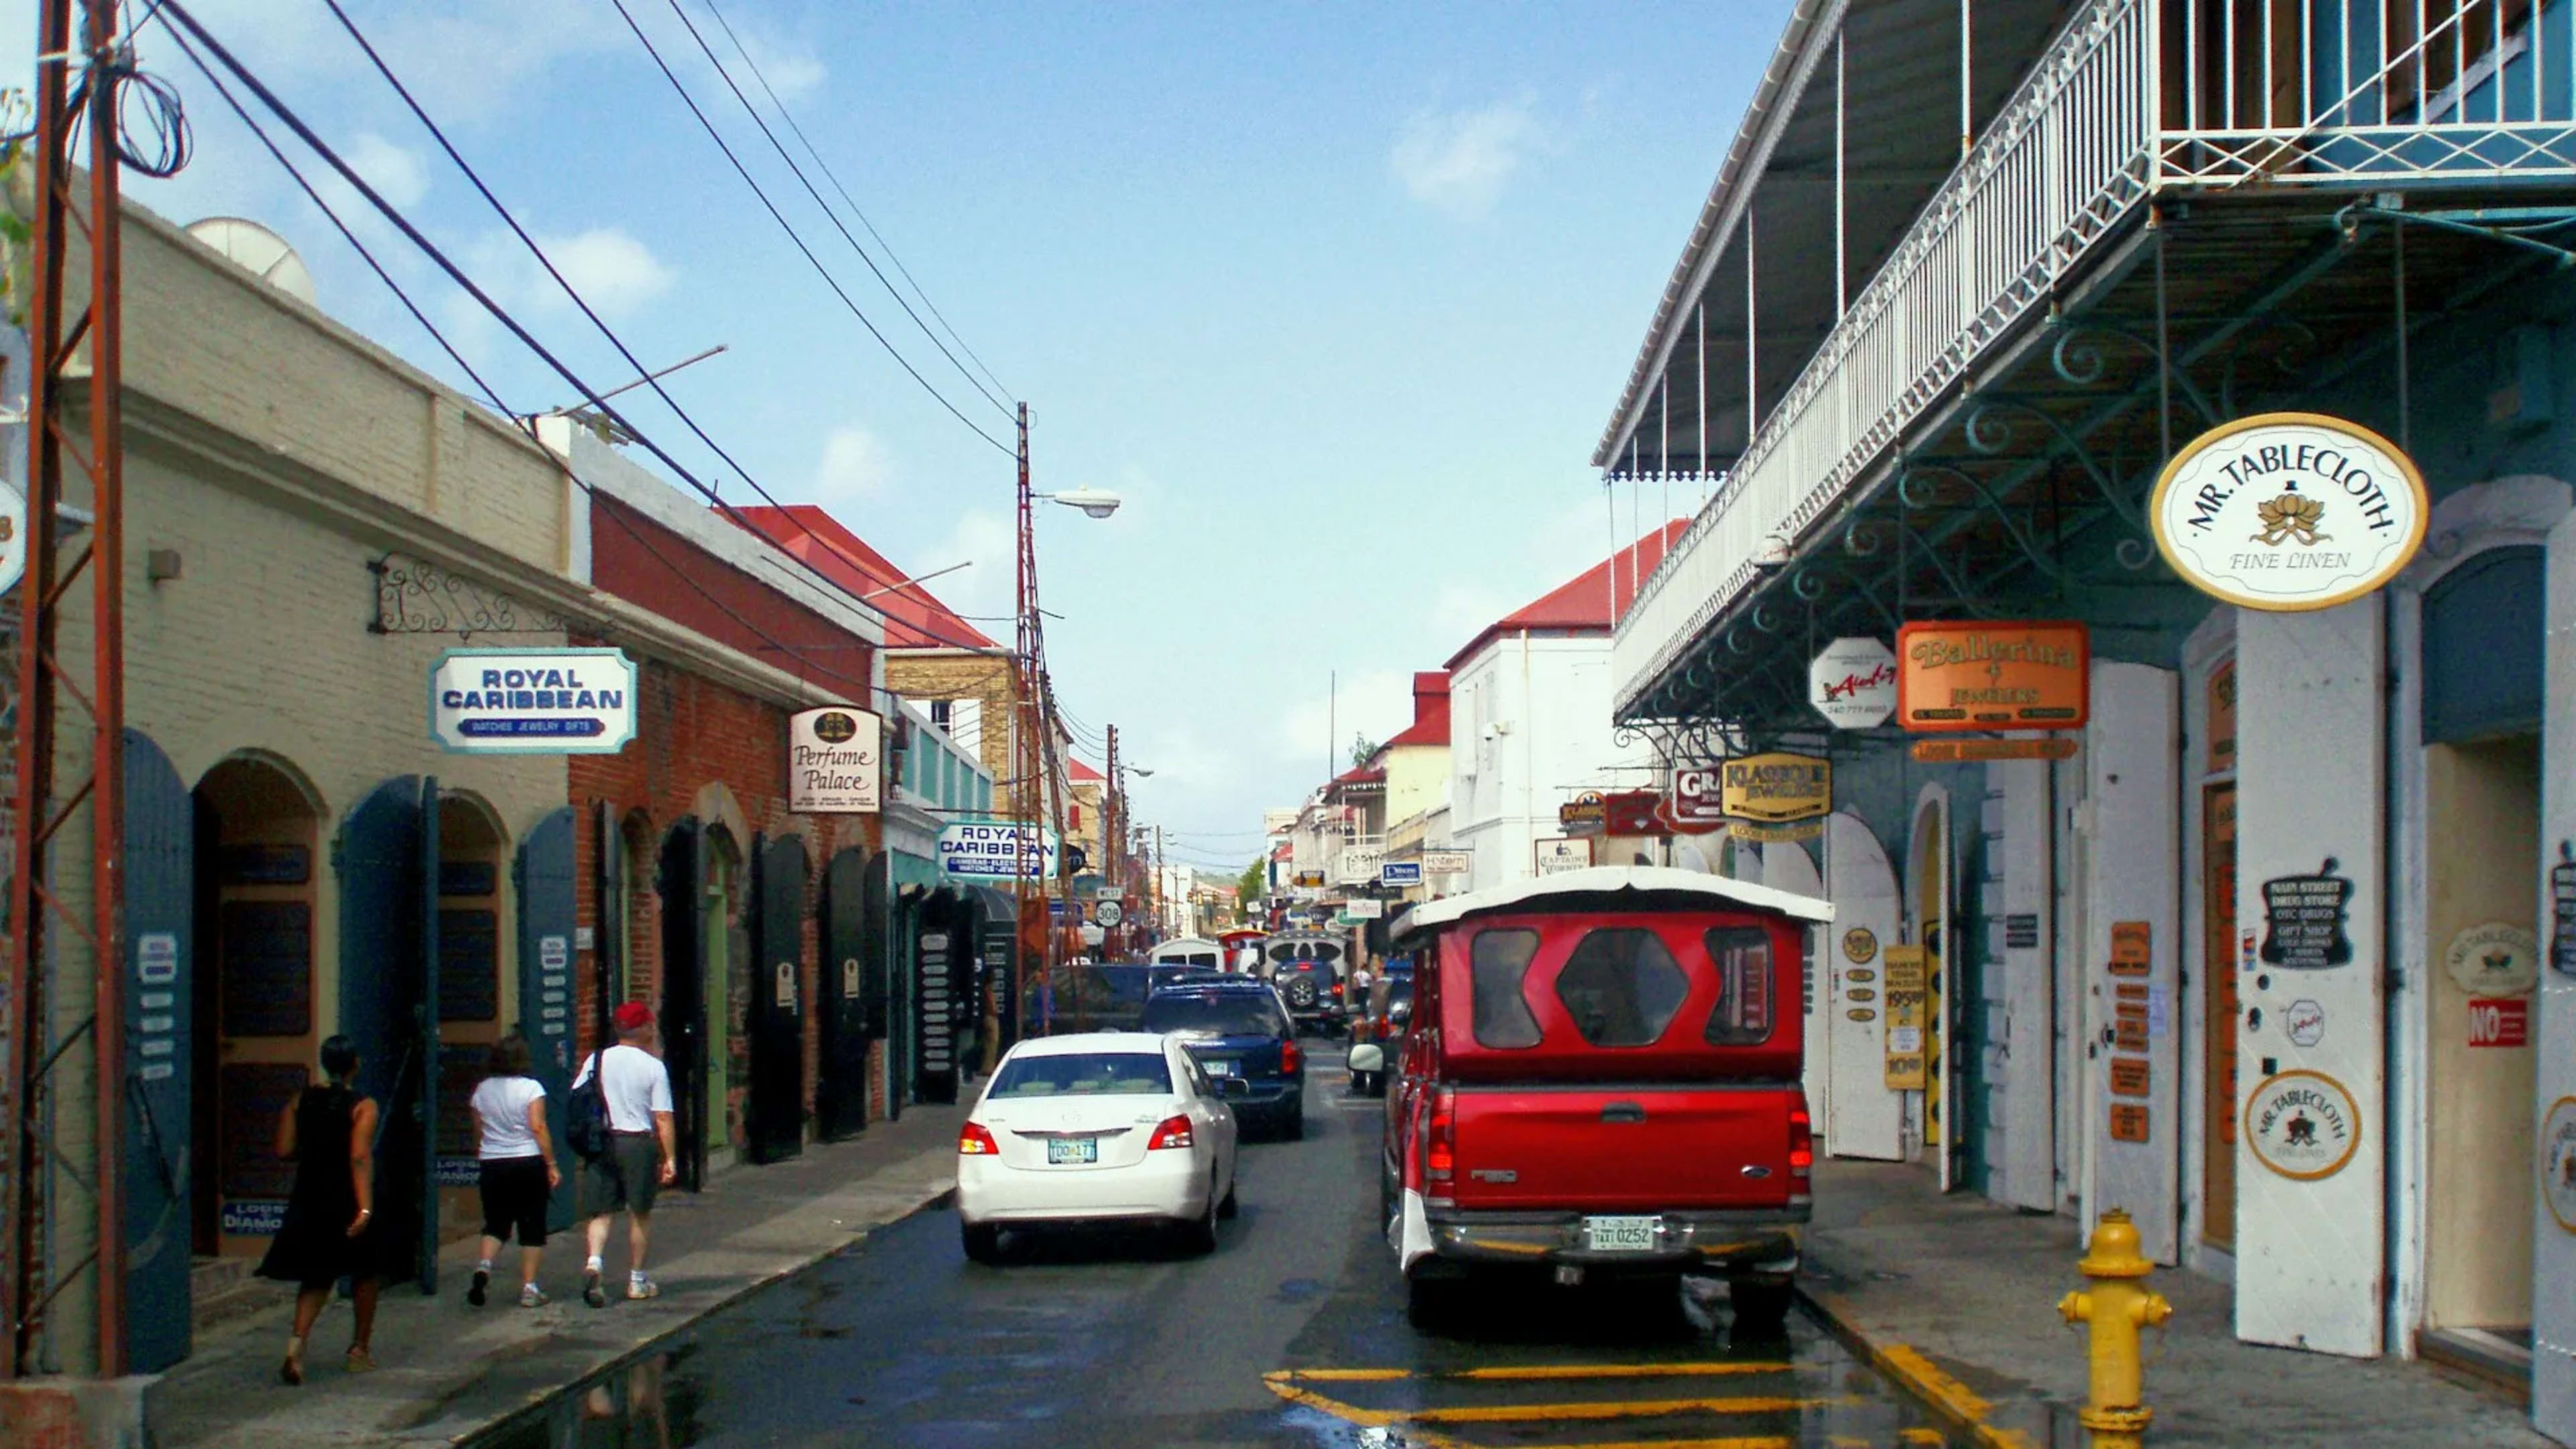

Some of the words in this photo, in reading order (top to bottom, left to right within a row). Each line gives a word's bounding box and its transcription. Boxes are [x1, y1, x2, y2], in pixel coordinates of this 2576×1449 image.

[2188, 483, 2235, 531] MR.
[2219, 444, 2395, 531] TABLECLOTH
[2230, 553, 2281, 570] FINE
[2286, 552, 2351, 570] LINEN
[1911, 634, 2076, 669] Ballerina
[482, 669, 583, 688] ROYAL
[442, 690, 623, 710] CARIBBEAN
[519, 722, 558, 731] JEWELRY
[794, 745, 875, 769] Perfume
[804, 769, 870, 790] Palace
[962, 827, 1036, 842] ROYAL
[941, 841, 1054, 857] CARIBBEAN
[2300, 881, 2340, 893] STREET
[1098, 907, 1119, 920] 308
[2469, 1006, 2501, 1042] NO
[2271, 1089, 2346, 1138] TABLECLOTH
[224, 1214, 283, 1228] DIAMO
[1617, 1228, 1649, 1243] 0252
